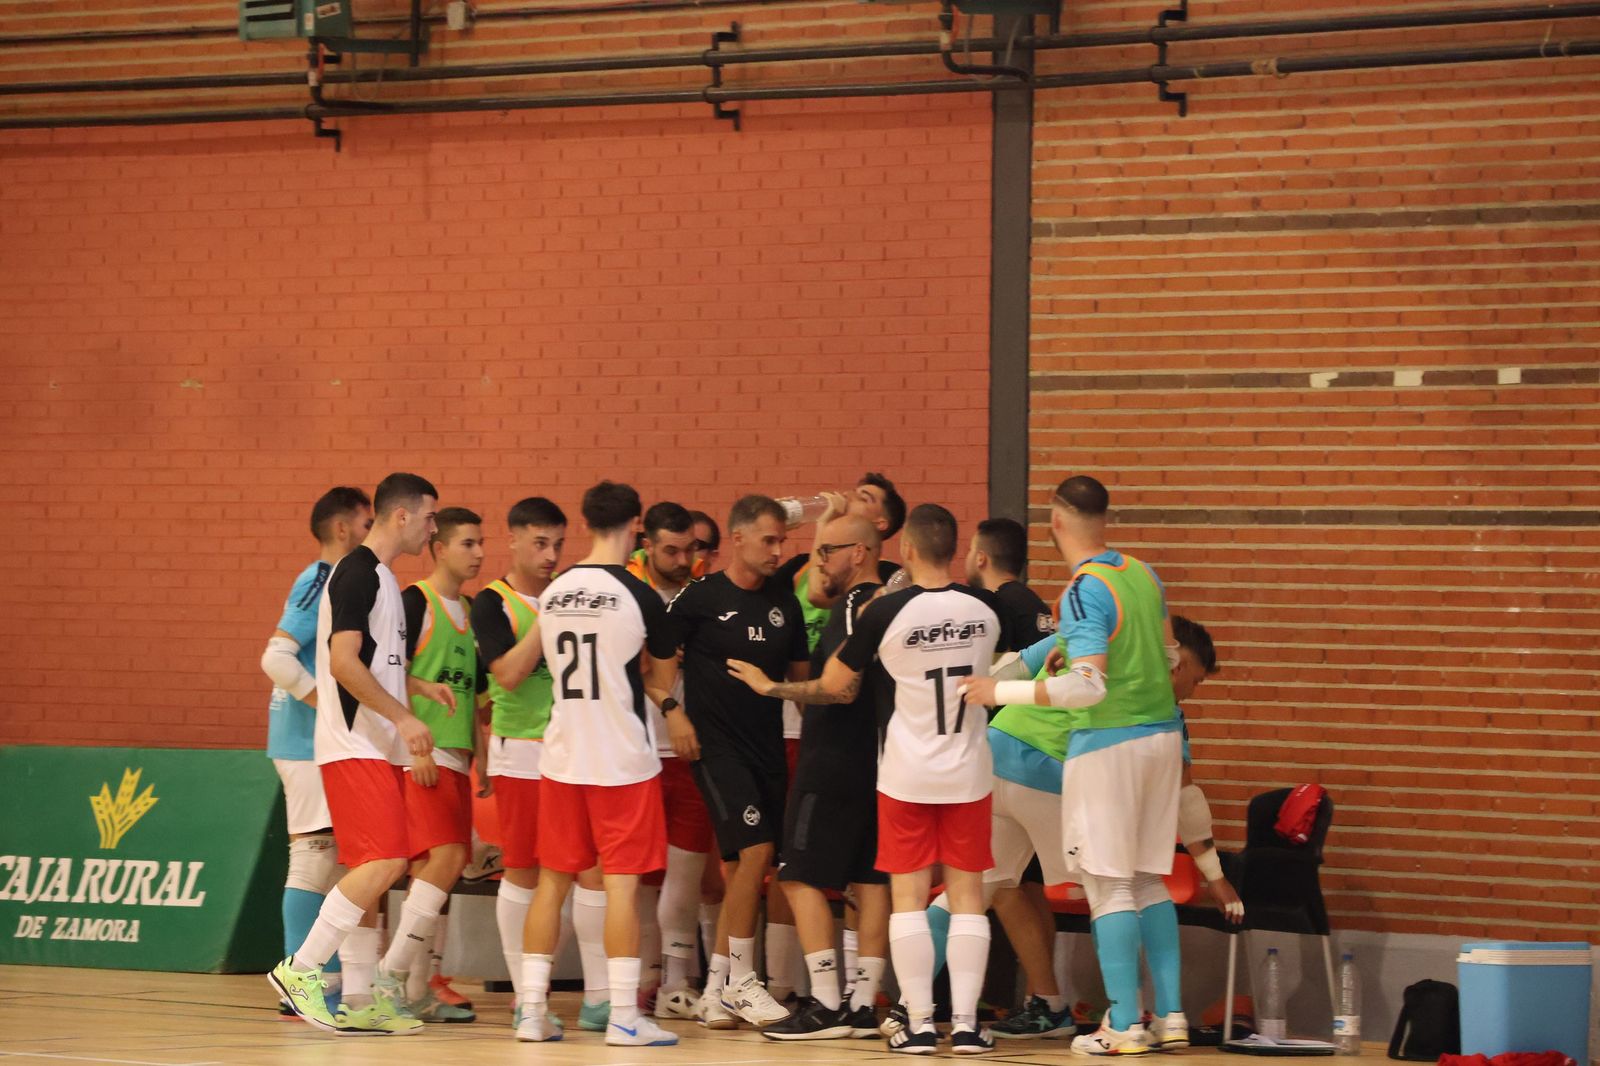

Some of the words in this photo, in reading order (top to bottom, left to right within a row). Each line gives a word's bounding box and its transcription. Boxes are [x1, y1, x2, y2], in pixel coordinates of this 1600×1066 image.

[557, 630, 600, 700] 21
[925, 665, 973, 735] 17
[71, 858, 207, 907] RURAL
[14, 915, 48, 938] DE
[50, 917, 141, 942] ZAMORA
